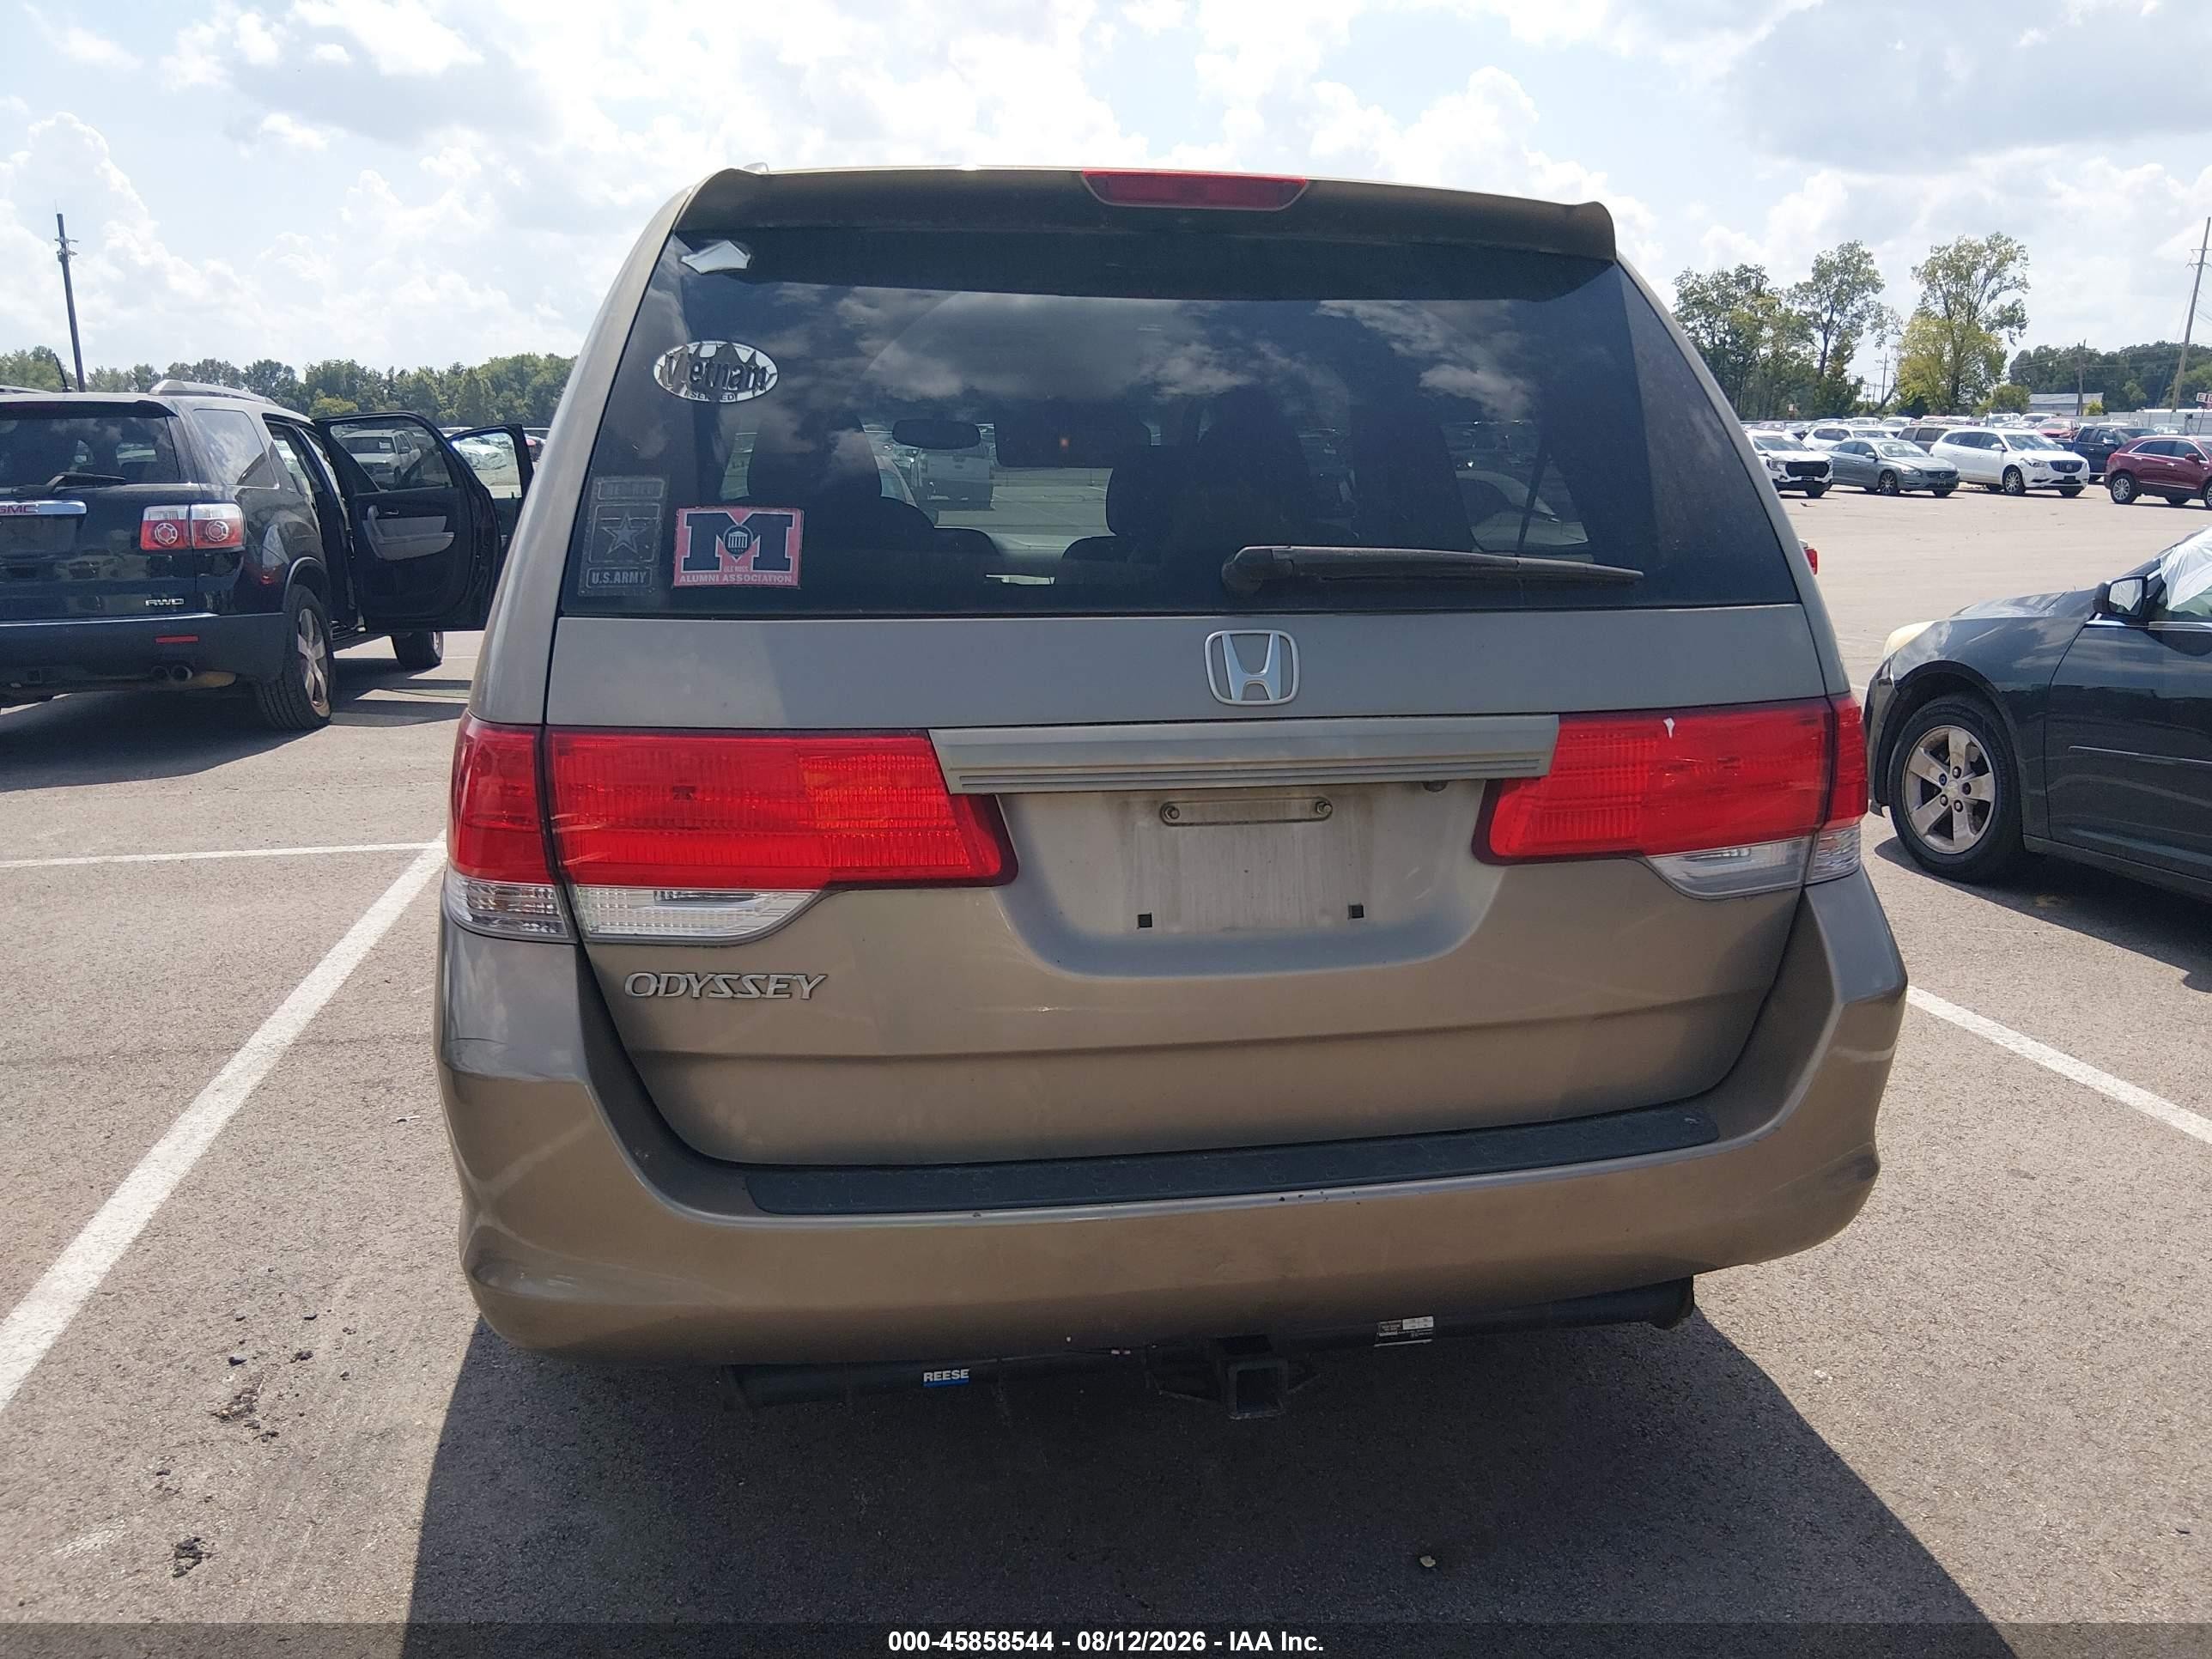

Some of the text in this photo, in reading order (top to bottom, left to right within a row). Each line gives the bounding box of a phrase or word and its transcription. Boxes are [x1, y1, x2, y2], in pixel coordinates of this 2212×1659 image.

[0, 505, 37, 514] GMC
[679, 574, 792, 583] ALUMNI ASSOCIATION
[624, 972, 827, 1000] ODYSSEY
[923, 1369, 969, 1382] REESE
